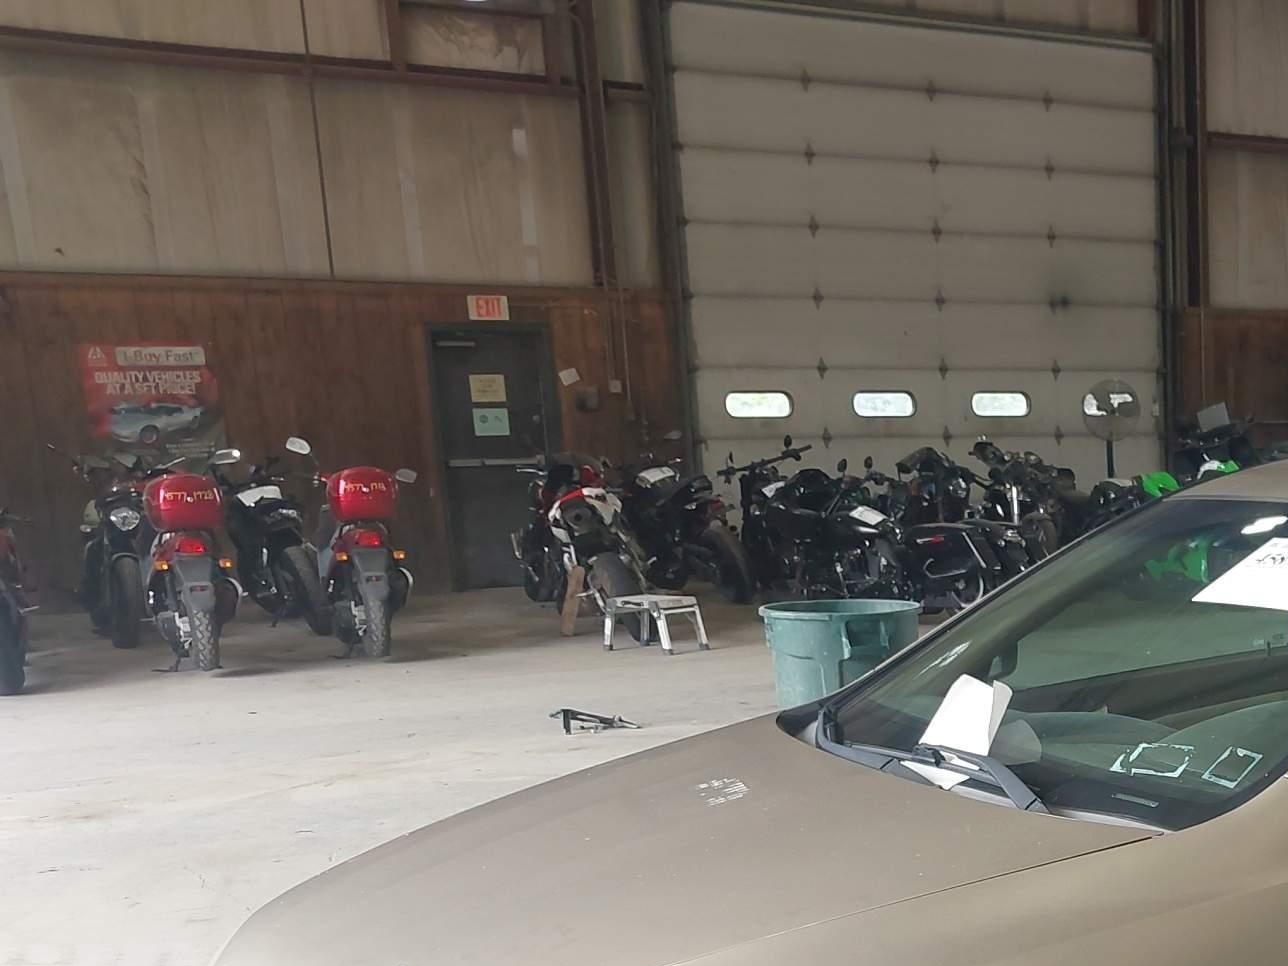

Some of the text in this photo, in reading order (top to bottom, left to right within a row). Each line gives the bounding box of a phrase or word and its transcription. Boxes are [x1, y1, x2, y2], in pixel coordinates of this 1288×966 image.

[475, 297, 501, 317] EXIT
[166, 350, 193, 361] Fast
[94, 371, 201, 384] QUALITY VEHICLES
[106, 383, 122, 395] AT
[124, 383, 135, 395] A
